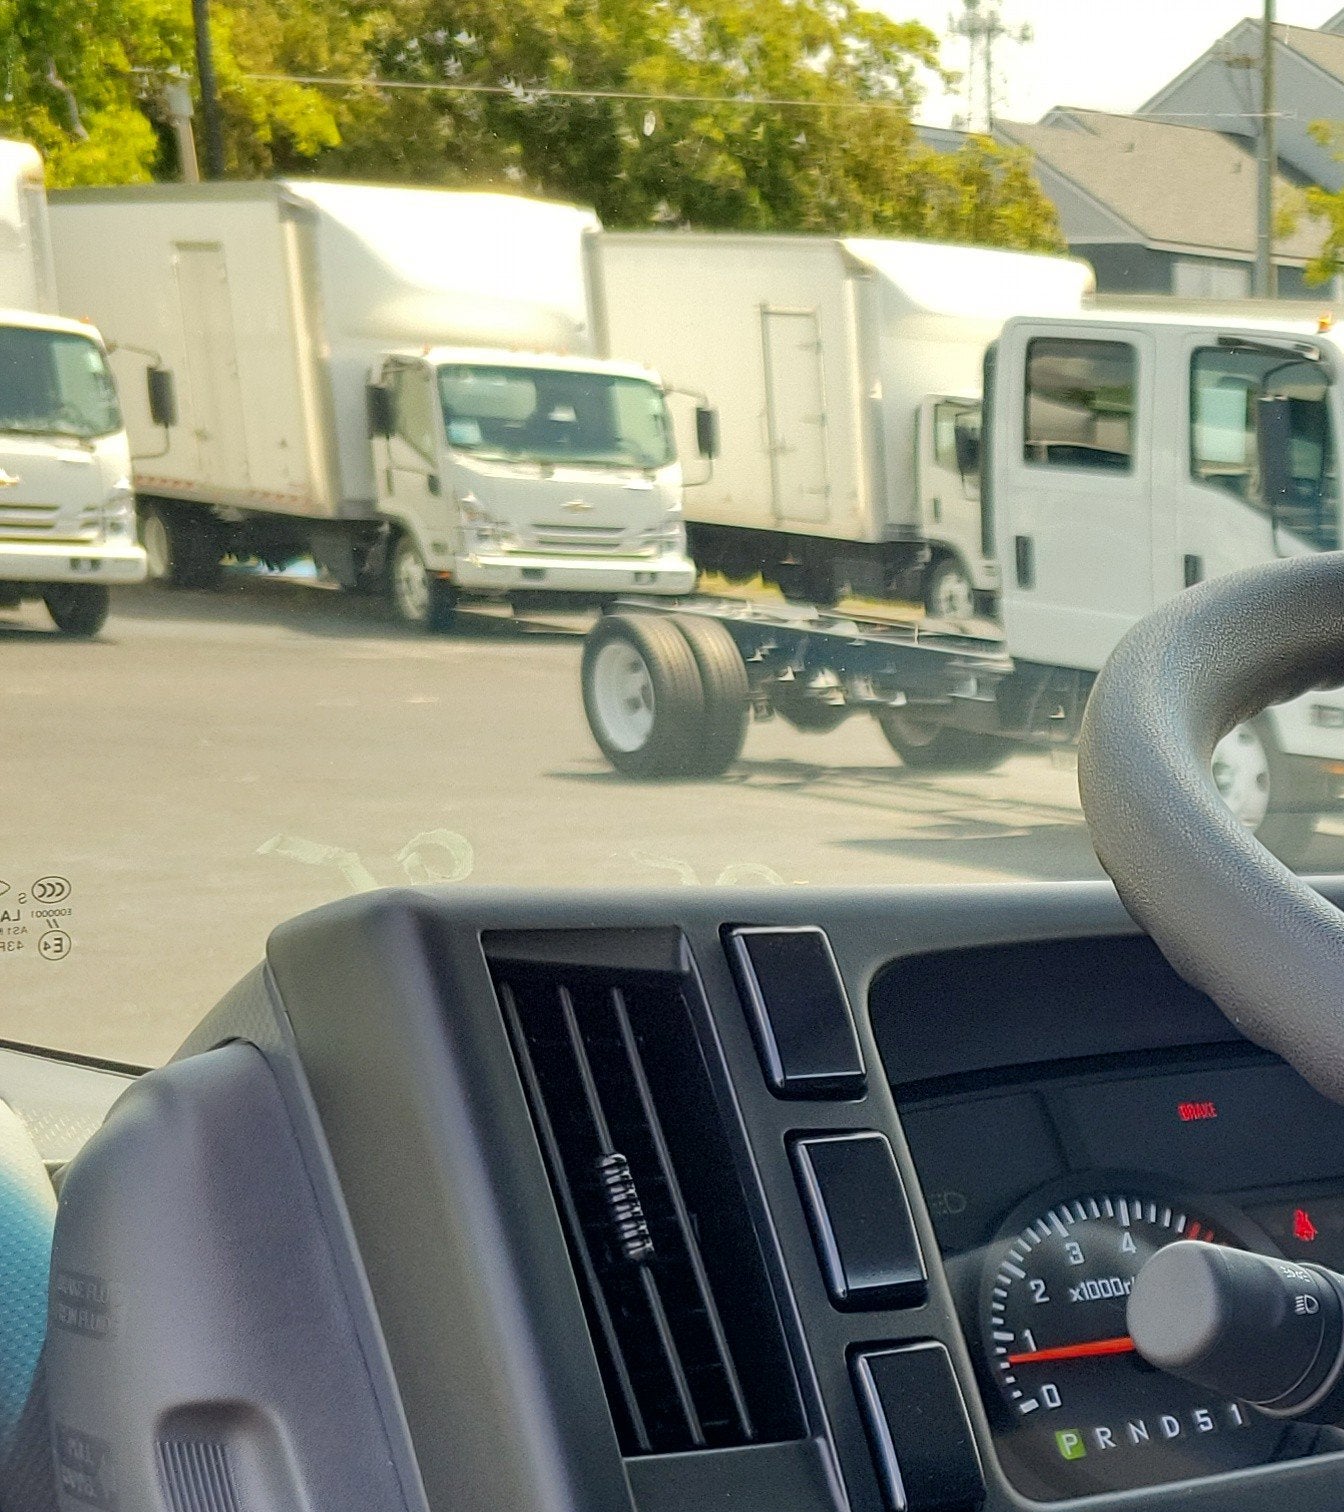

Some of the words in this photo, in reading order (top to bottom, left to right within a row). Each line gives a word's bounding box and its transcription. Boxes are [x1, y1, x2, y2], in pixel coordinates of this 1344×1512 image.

[1065, 1241, 1085, 1265] 3
[1122, 1231, 1137, 1254] 4
[1029, 1278, 1050, 1303] 2
[1024, 1328, 1037, 1351] 1
[1040, 1383, 1062, 1409] 0
[1061, 1433, 1080, 1455] P
[1095, 1427, 1117, 1450] R
[1129, 1420, 1150, 1444] N
[1161, 1415, 1181, 1438] D
[1194, 1409, 1214, 1432] 5
[1230, 1403, 1243, 1426] 1
